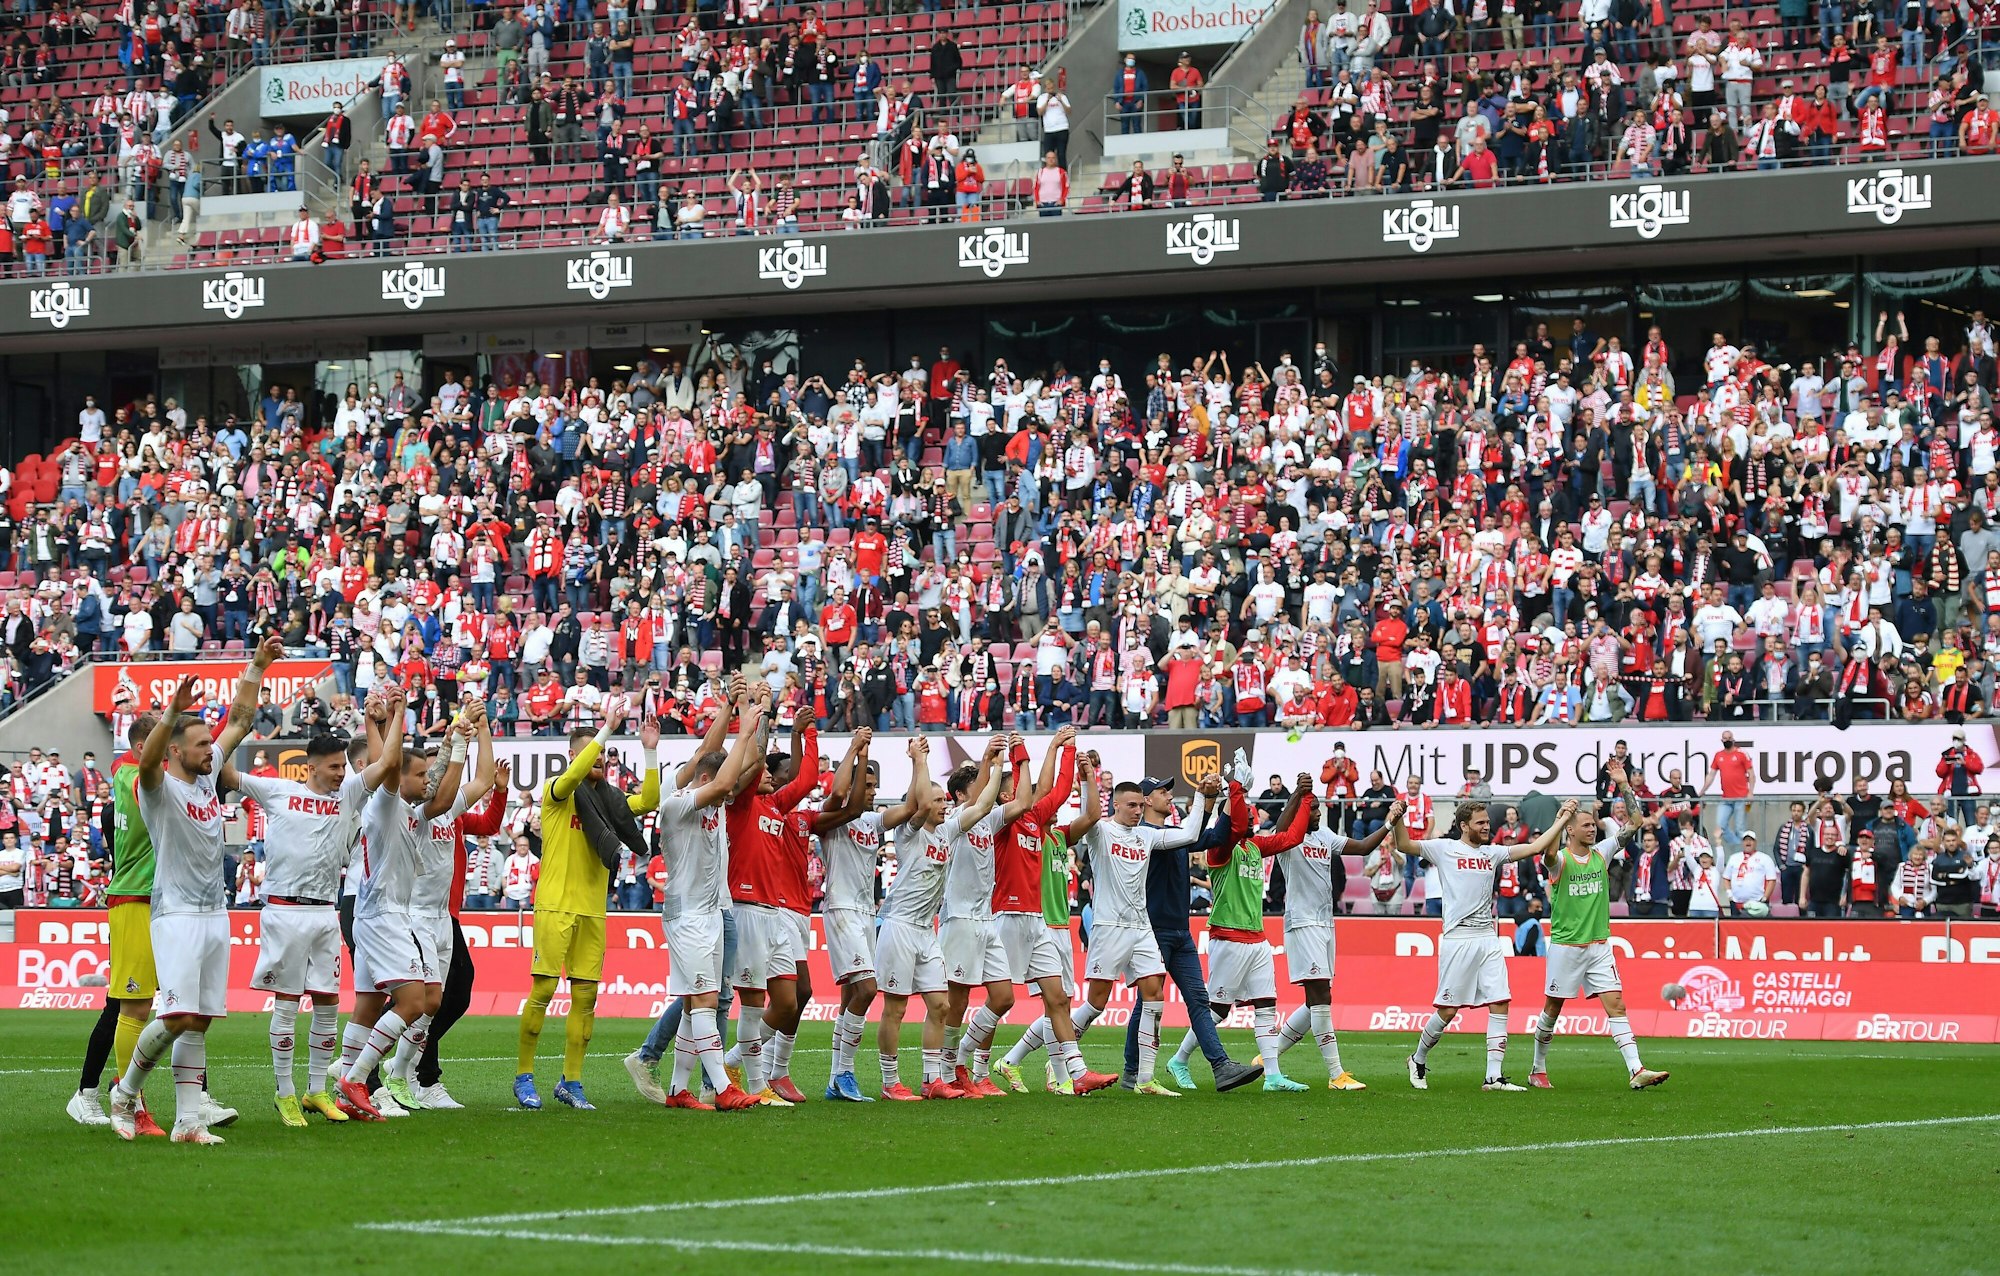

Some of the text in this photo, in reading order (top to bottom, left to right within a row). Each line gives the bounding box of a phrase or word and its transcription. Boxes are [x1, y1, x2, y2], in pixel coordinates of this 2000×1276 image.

[1152, 3, 1264, 33] Rosbacher
[288, 74, 371, 100] Rosbach
[1374, 740, 1912, 785] Mit UPS drch uropa
[288, 795, 340, 815] REWE
[1111, 843, 1148, 861] REWE
[1303, 845, 1331, 860] REW
[1457, 858, 1493, 871] REWE
[1569, 870, 1602, 883] uhlsport
[1568, 880, 1603, 896] REWE
[18, 949, 110, 988] BoC
[1752, 972, 1841, 989] CASTELLI
[19, 989, 94, 1009] DERTOUR
[1684, 979, 1740, 1010] ASTELLI
[1752, 989, 1852, 1007] FORMAGGI
[1687, 1014, 1788, 1039] DERTOUR
[1856, 1015, 1960, 1041] DERTOUR
